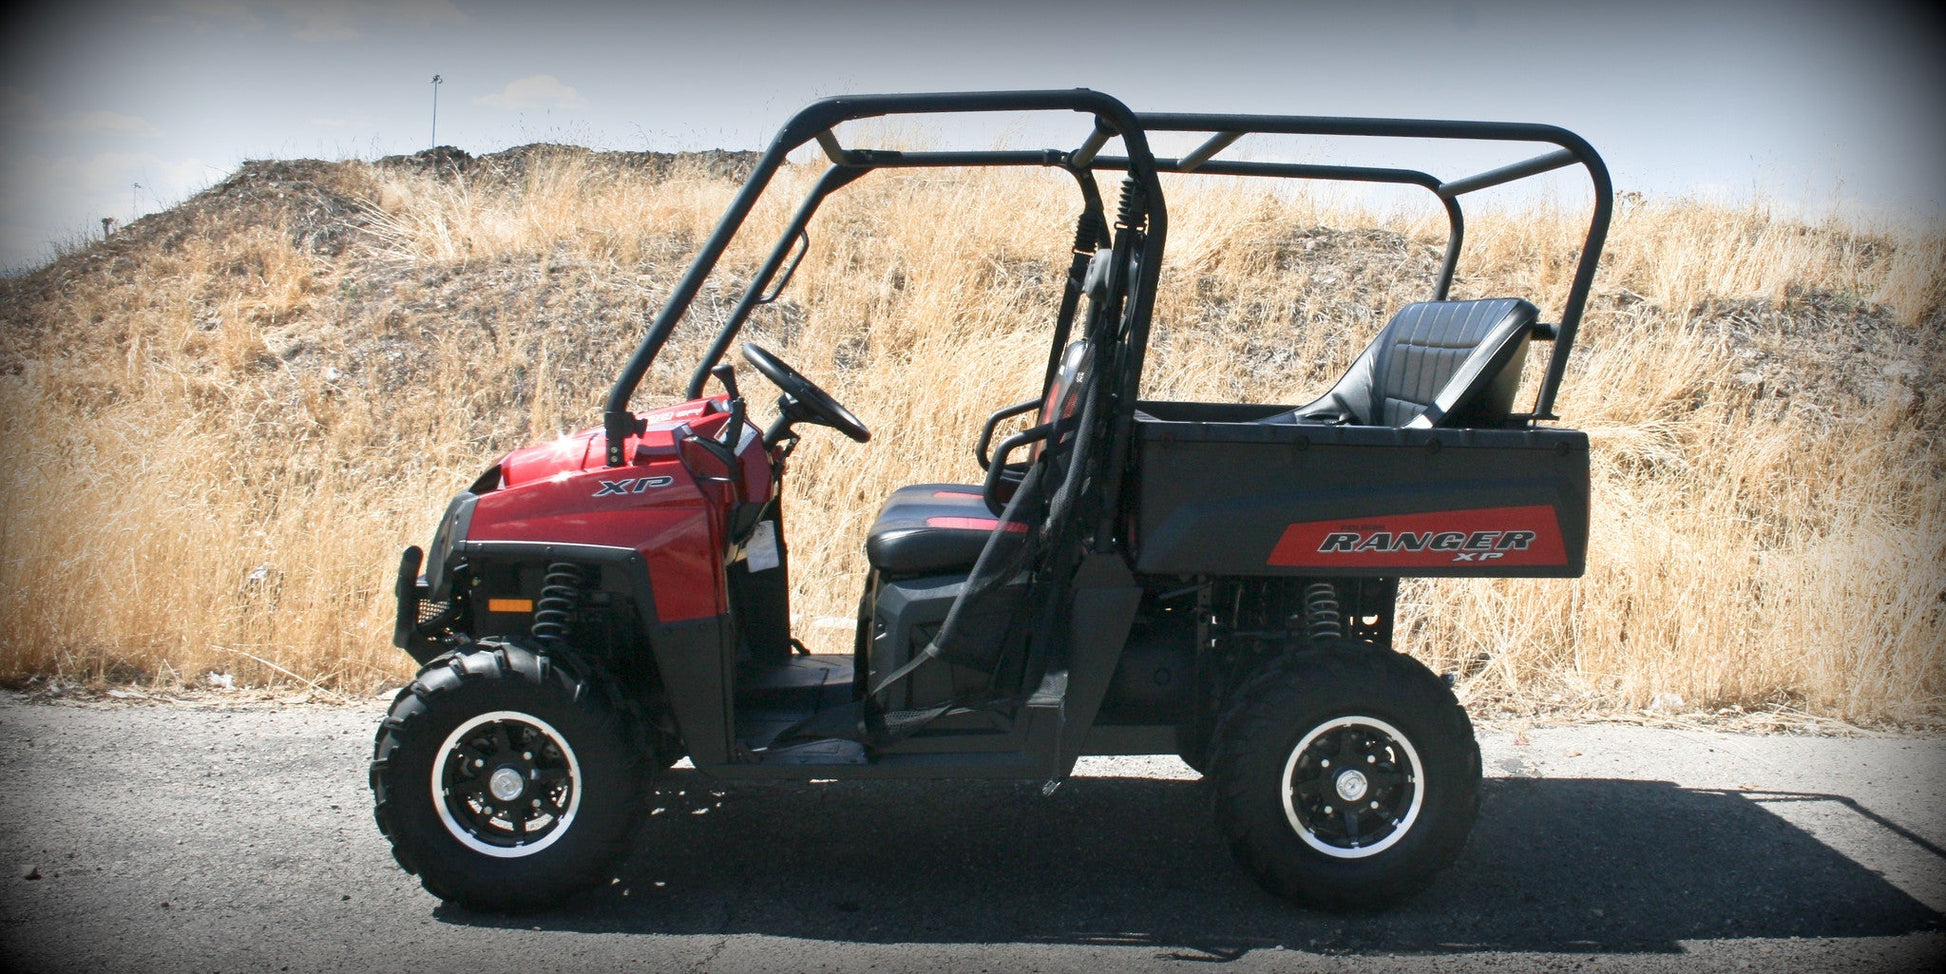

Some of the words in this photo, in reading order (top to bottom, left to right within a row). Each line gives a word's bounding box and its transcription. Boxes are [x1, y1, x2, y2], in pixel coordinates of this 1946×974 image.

[592, 475, 673, 497] XP
[1317, 530, 1536, 552] RANGER
[1452, 552, 1504, 562] XP
